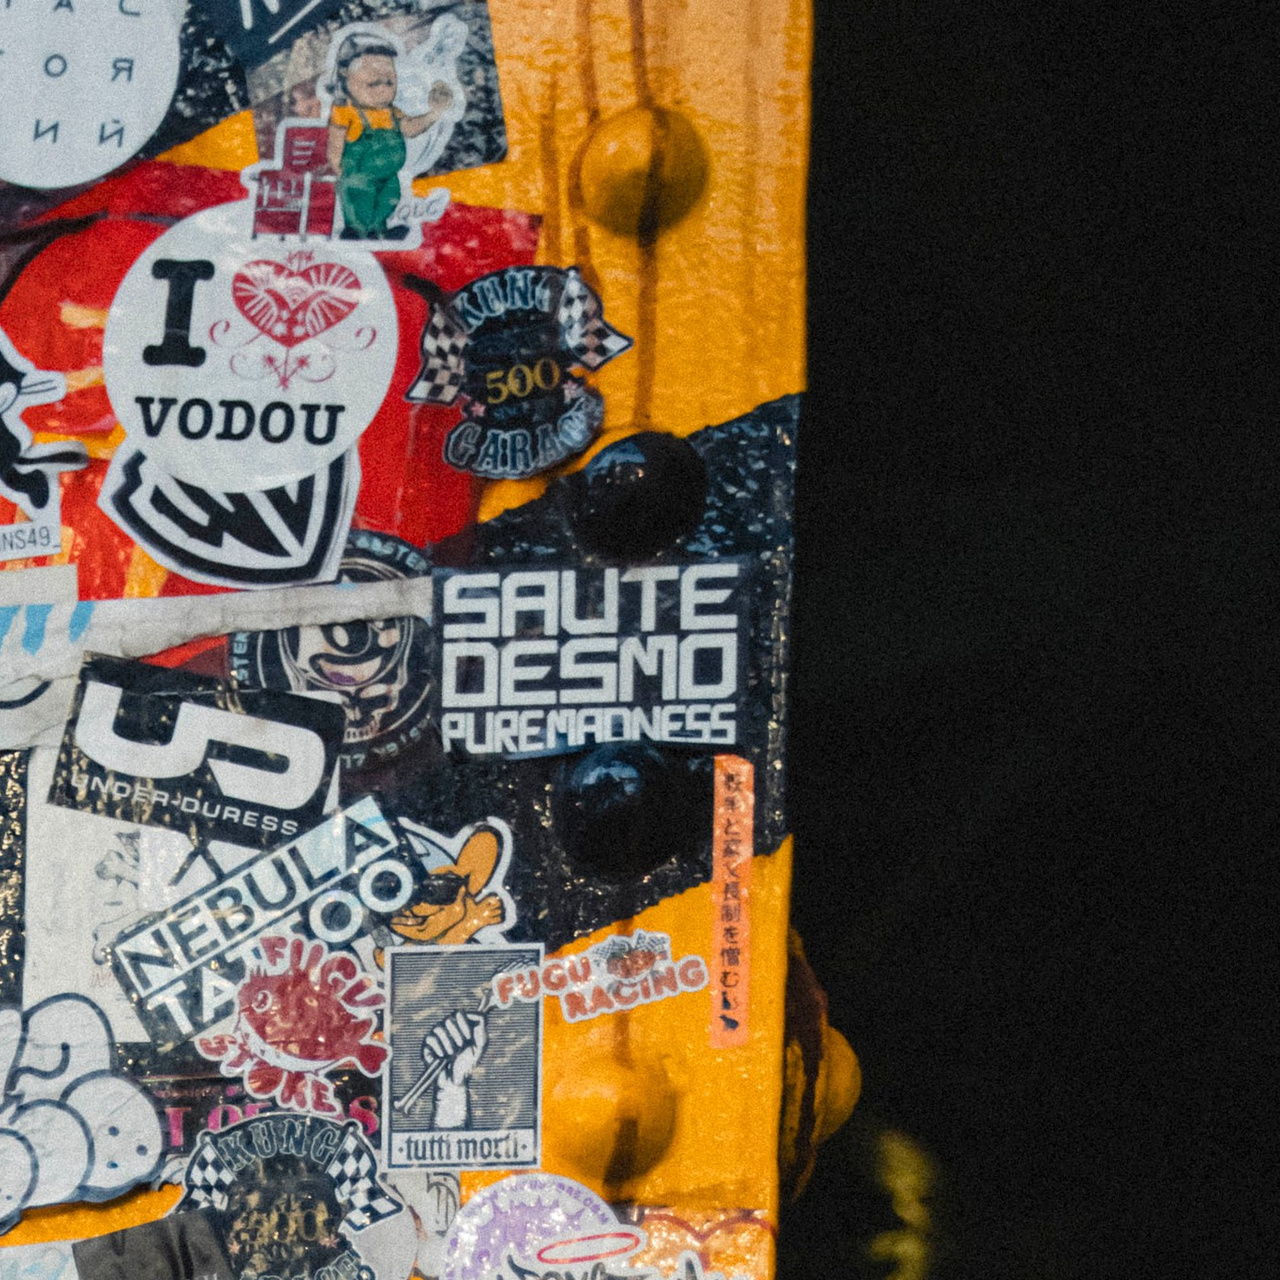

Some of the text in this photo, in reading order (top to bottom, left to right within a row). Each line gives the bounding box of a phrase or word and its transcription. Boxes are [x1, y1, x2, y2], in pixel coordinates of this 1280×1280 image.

[142, 259, 217, 368] I
[486, 358, 561, 404] 500
[135, 396, 346, 445] VODOU
[442, 562, 740, 640] SAUTE
[440, 632, 738, 709] DESMO
[440, 702, 738, 755] PUREMADNESS
[120, 815, 391, 996] NEBULA
[146, 857, 415, 1036] TATOO
[259, 934, 387, 1010] FUGU
[497, 955, 592, 1004] FUGU
[563, 955, 707, 1020] RACING
[220, 1118, 341, 1172] KUNG
